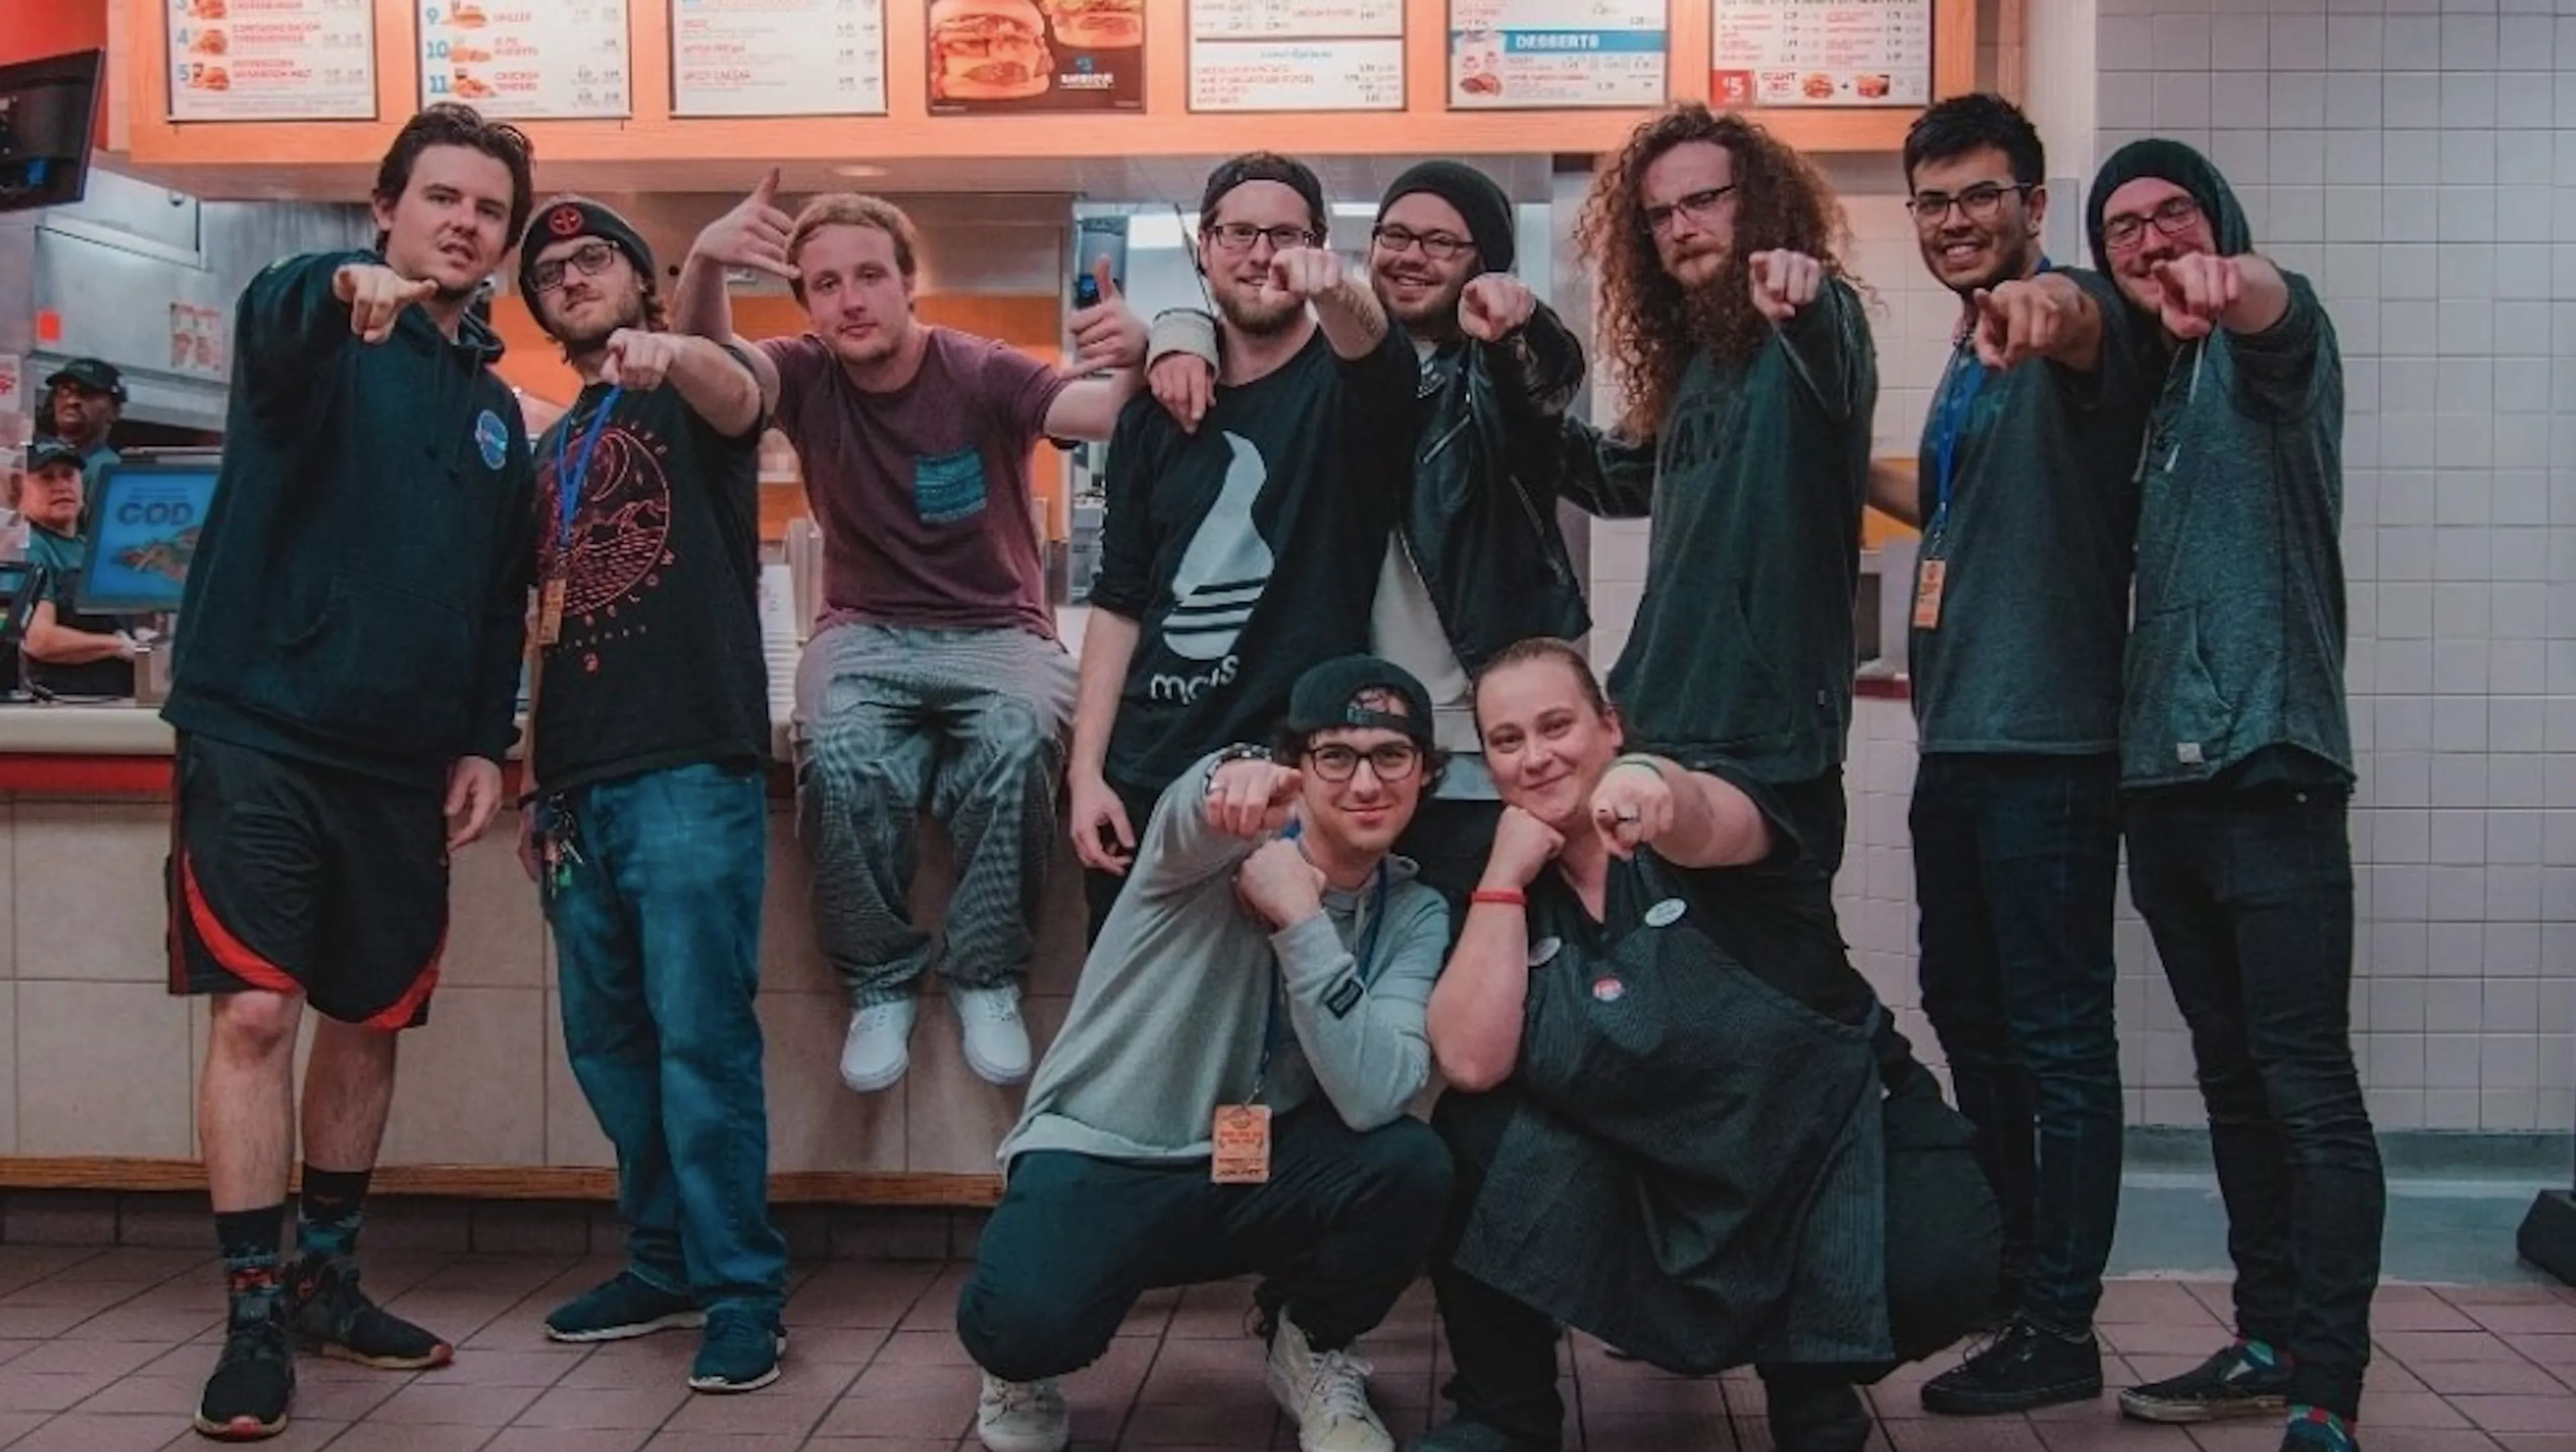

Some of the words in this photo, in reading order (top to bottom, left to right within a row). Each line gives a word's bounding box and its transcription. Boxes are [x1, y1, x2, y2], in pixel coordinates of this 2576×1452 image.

[425, 6, 440, 25] 9
[176, 27, 189, 44] 4
[1515, 34, 1600, 50] DESSERTS
[426, 40, 449, 60] 10
[178, 64, 189, 81] 5
[429, 74, 450, 94] 11
[117, 502, 195, 526] COD
